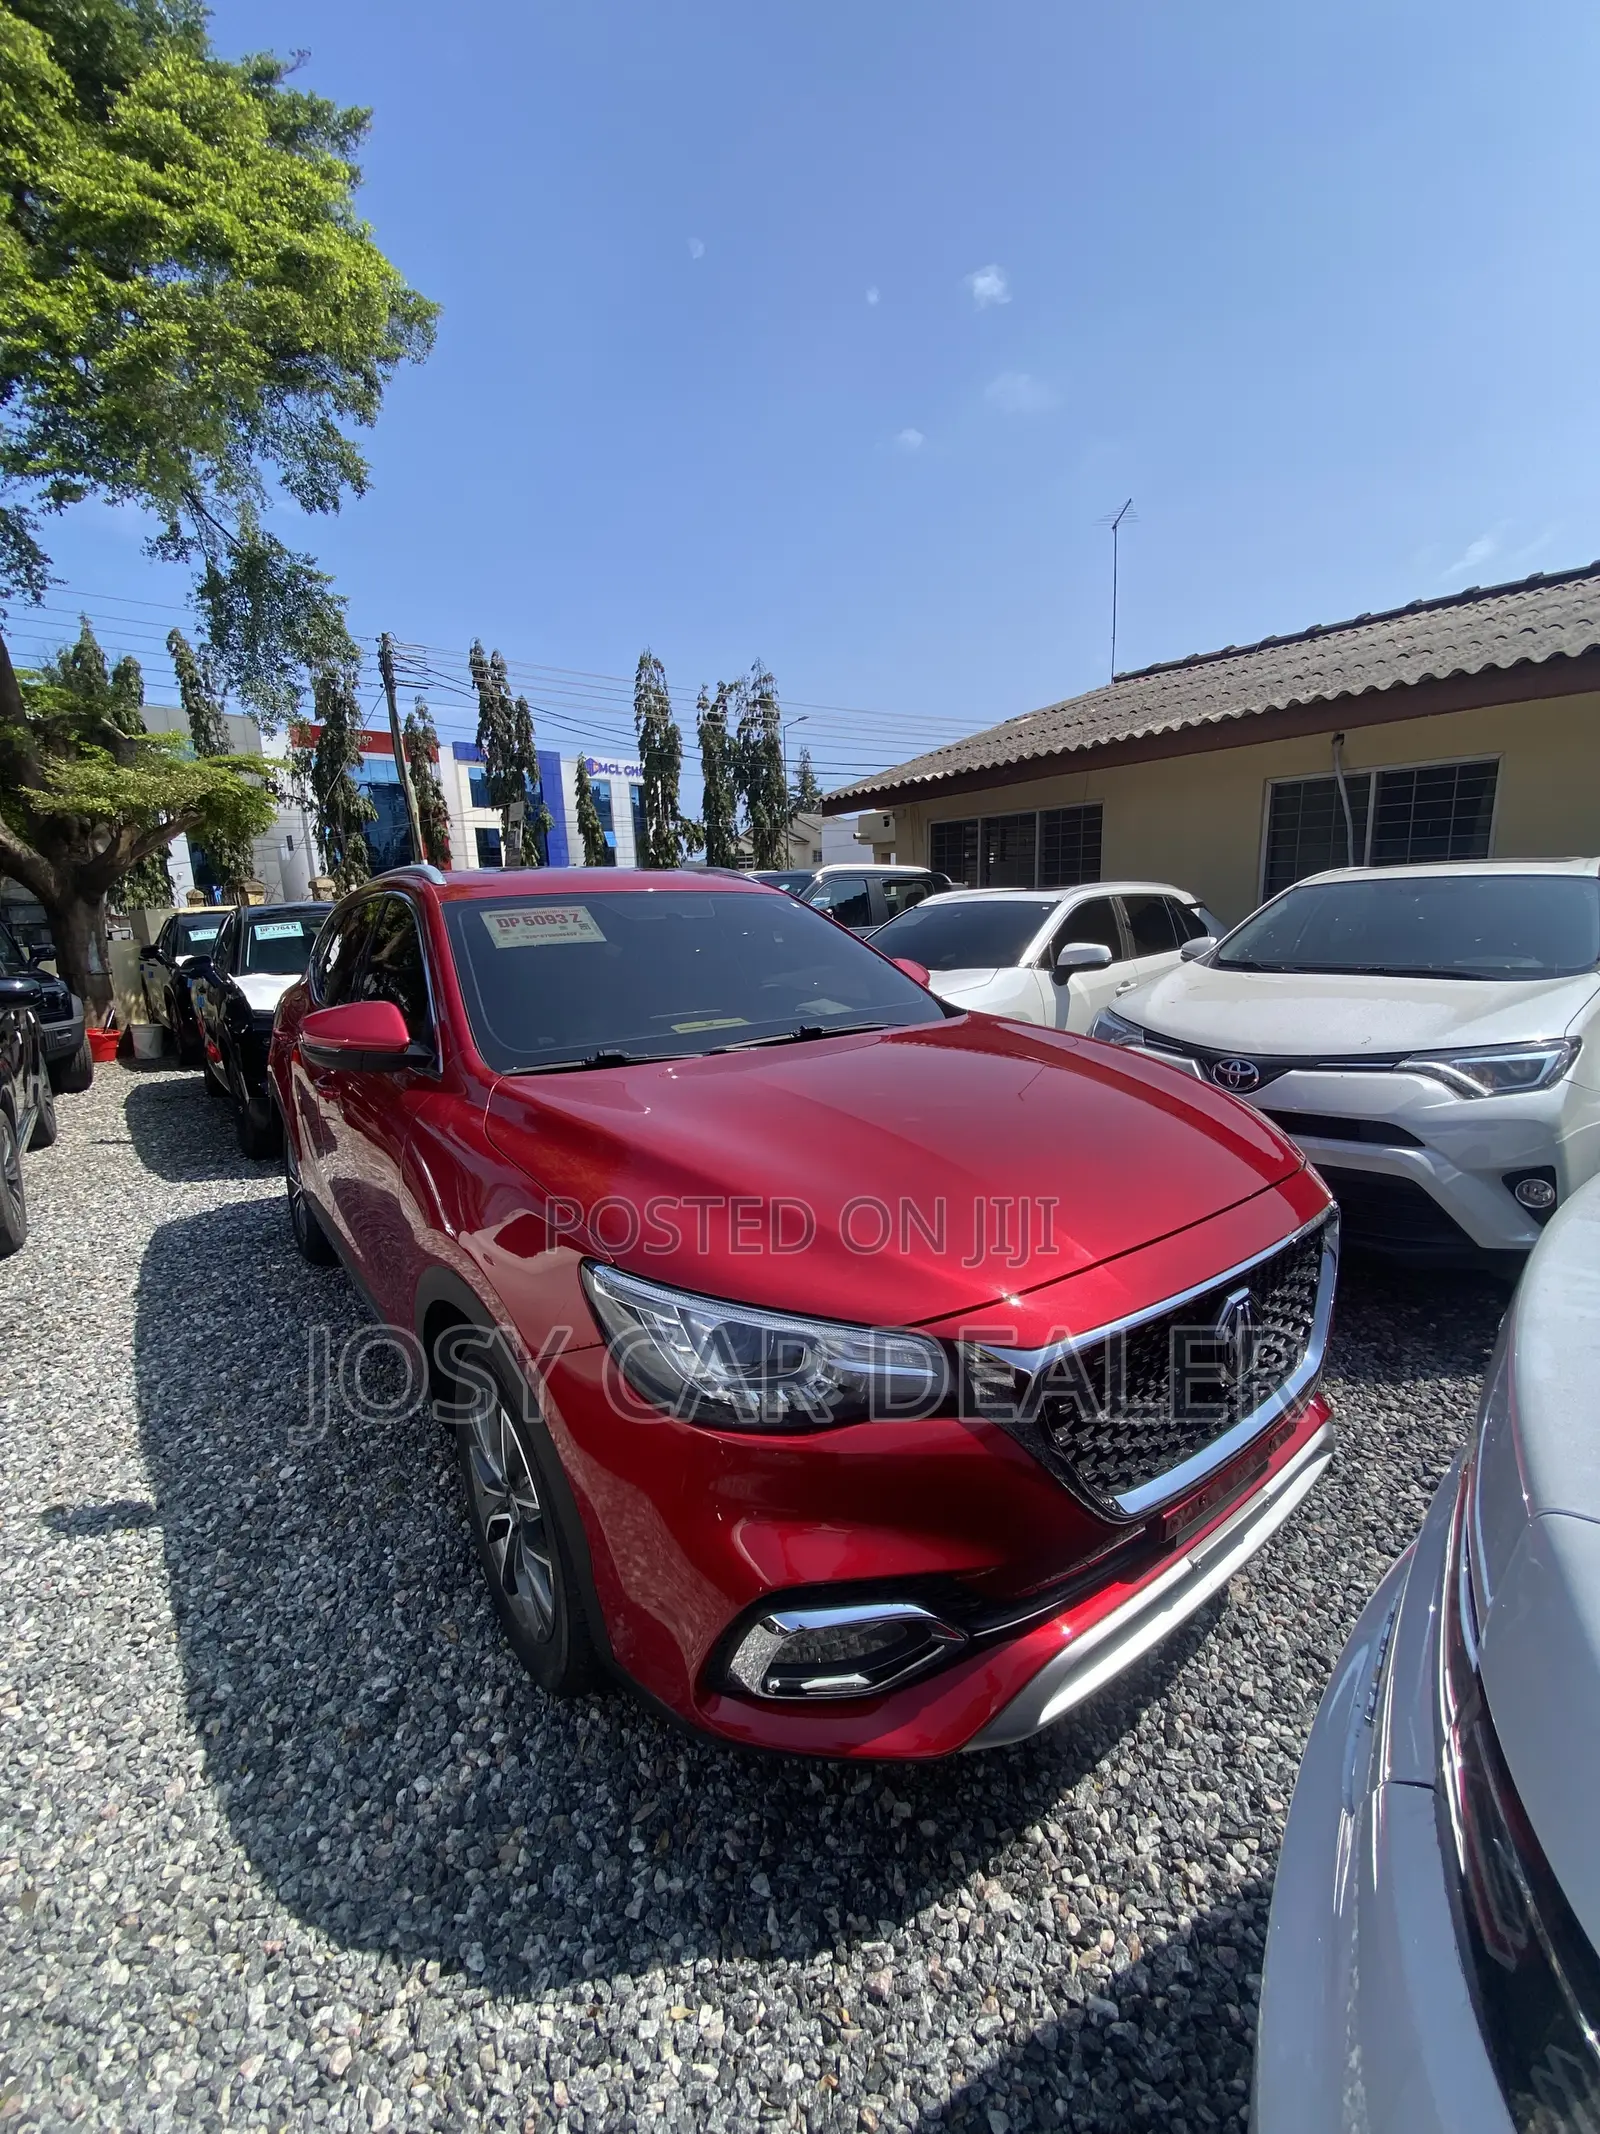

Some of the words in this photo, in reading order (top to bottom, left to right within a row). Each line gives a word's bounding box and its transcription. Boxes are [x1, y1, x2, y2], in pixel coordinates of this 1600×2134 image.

[599, 763, 622, 776] MCL
[496, 917, 520, 928] DP
[523, 913, 568, 926] 5093
[569, 913, 583, 923] Z
